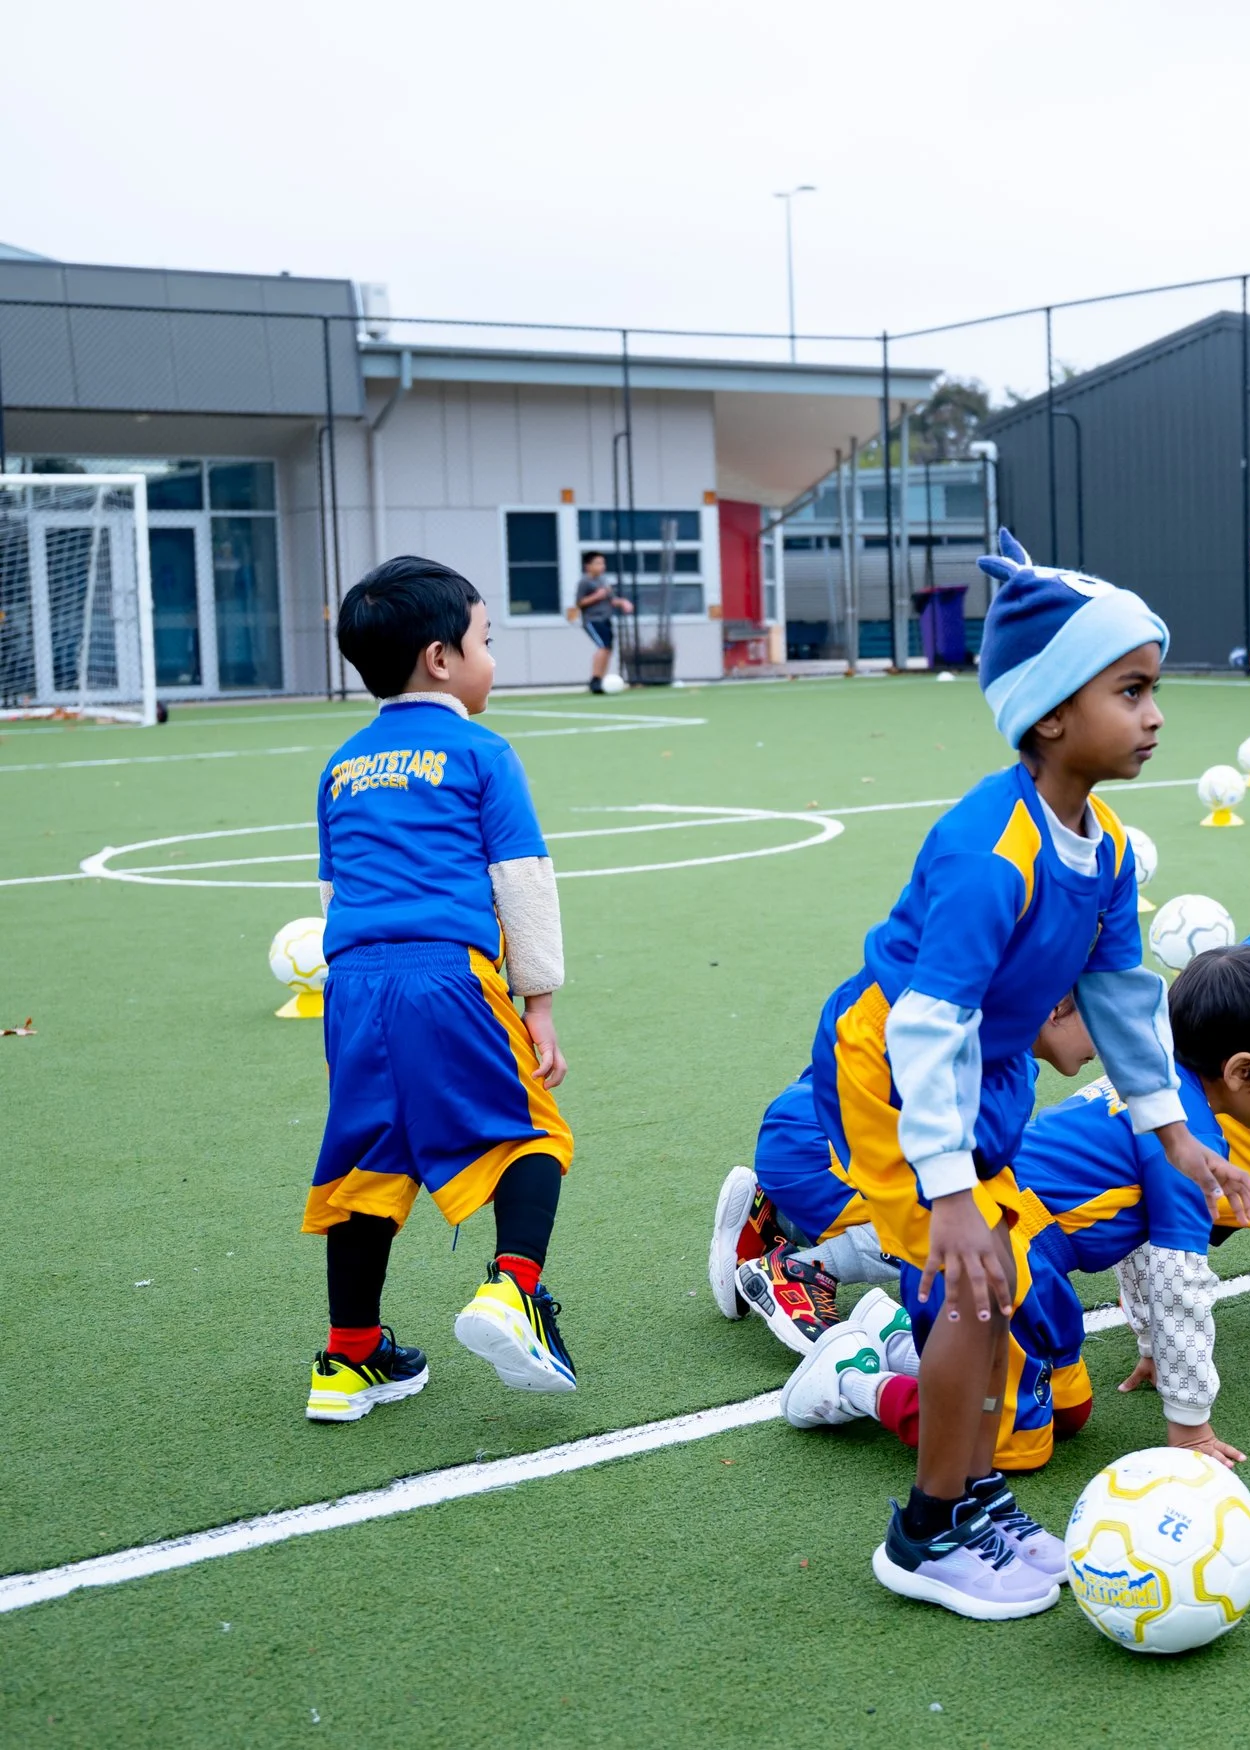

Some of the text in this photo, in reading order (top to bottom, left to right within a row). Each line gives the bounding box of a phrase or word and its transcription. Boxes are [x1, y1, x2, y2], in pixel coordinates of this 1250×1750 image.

[331, 749, 448, 801] BRIGHTSTARS
[351, 772, 409, 797] SOCCER
[1157, 1514, 1189, 1543] 32
